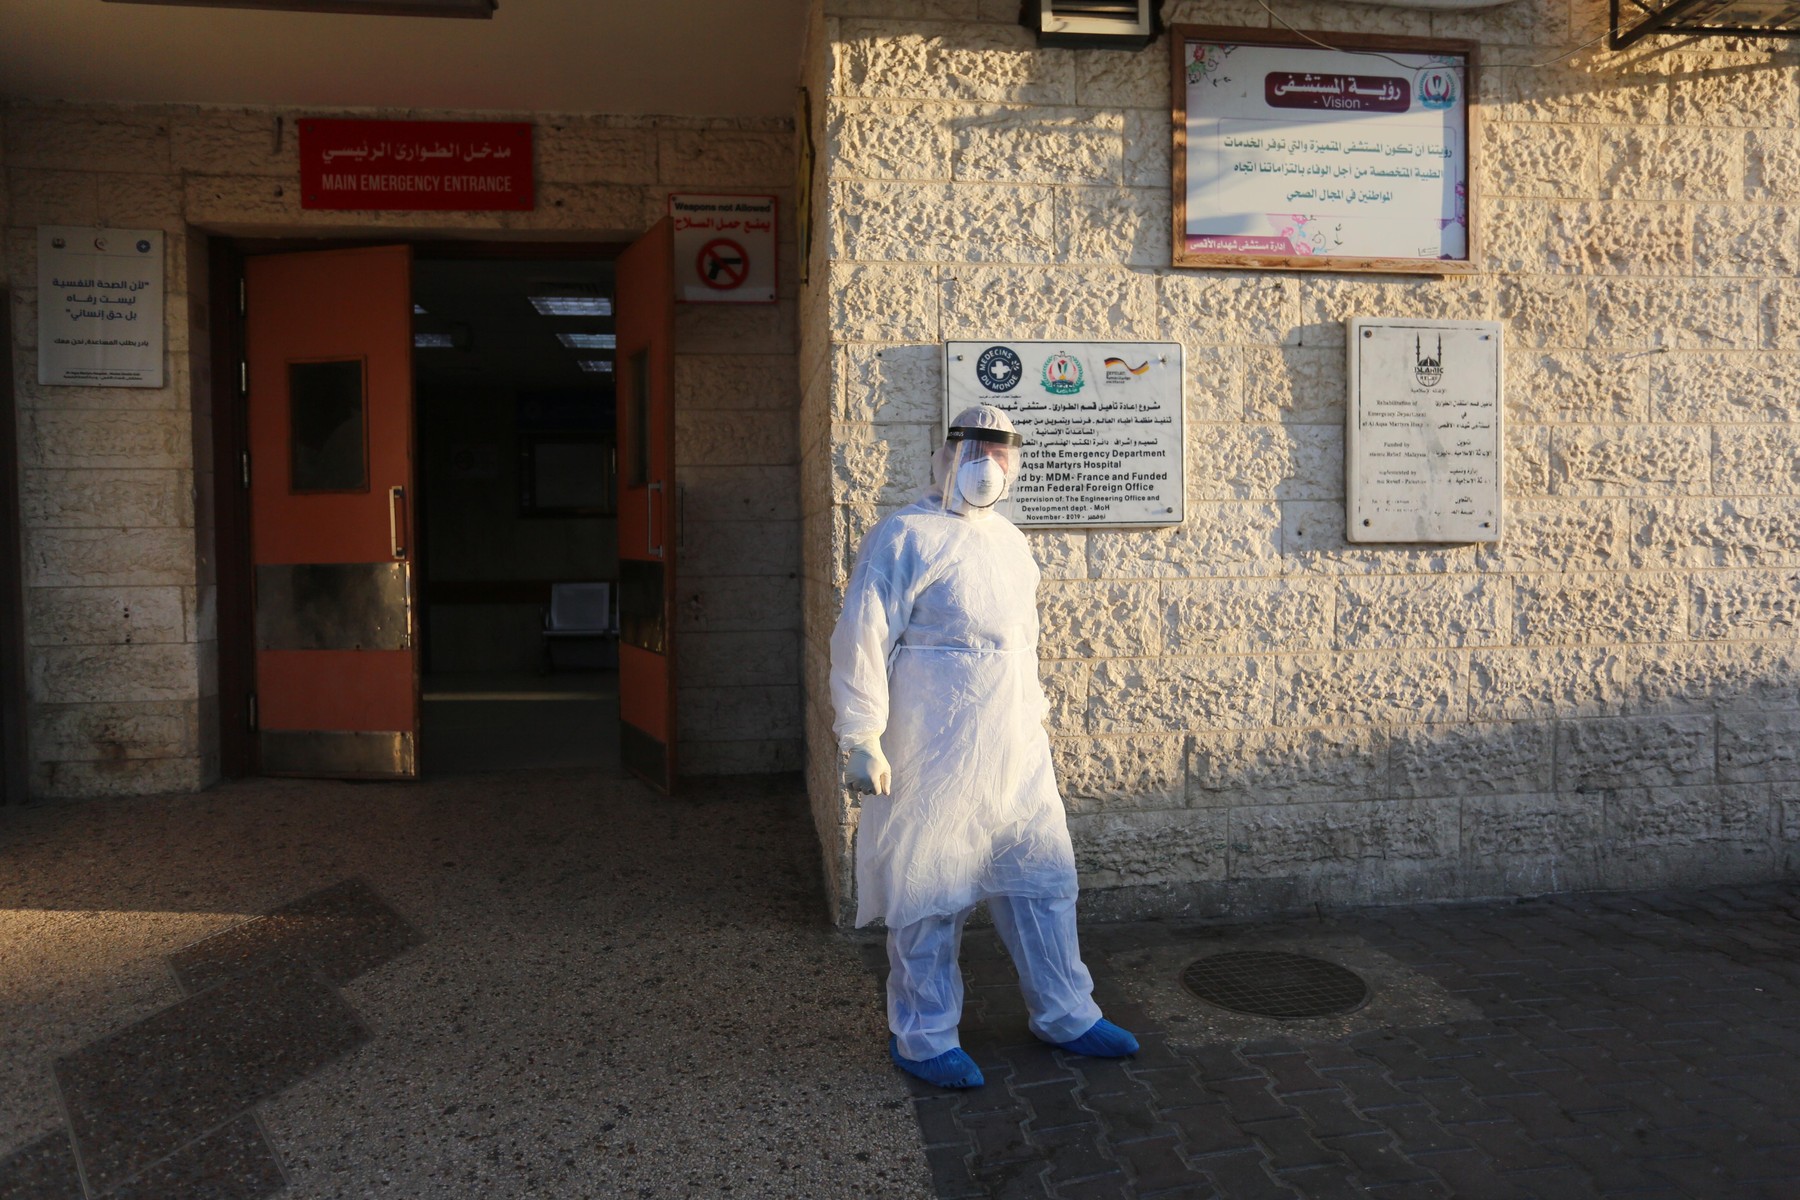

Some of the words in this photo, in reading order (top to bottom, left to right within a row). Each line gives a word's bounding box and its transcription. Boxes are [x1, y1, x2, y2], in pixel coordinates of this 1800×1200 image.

[1274, 73, 1345, 96] المستشفى
[1349, 78, 1401, 101] رؤية
[1321, 95, 1361, 109] Vision
[1224, 136, 1264, 149] الخدمات
[1267, 140, 1286, 151] توفر
[1288, 139, 1308, 155] والتي
[1310, 139, 1342, 154] المتميزة
[1344, 140, 1383, 154] المستشفى
[322, 140, 391, 164] الرئيسي
[394, 142, 460, 162] الطوارئ
[464, 142, 511, 162] مدخل
[1385, 144, 1413, 157] تكون
[1427, 144, 1453, 159] رؤيتنا
[1259, 163, 1305, 176] بالتزاماتنا
[1307, 165, 1331, 177] الوفاء
[1354, 167, 1367, 179] من
[1370, 165, 1412, 178] المتخصصة
[1415, 167, 1444, 181] الطبية
[322, 174, 357, 191] MAIN
[360, 174, 440, 192] EMERGENCY
[444, 175, 512, 192] ENTRANCE
[1287, 188, 1317, 202] الصحي
[1319, 189, 1344, 202] المجال
[1346, 189, 1356, 204] في
[1358, 191, 1393, 204] المواطنين
[675, 203, 716, 212] Weapons
[735, 204, 771, 212] Allowed
[675, 217, 714, 231] السلاح
[716, 217, 741, 231] حمل
[744, 218, 771, 233] يمنع
[1217, 239, 1238, 251] شهداء
[1238, 240, 1269, 251] مستشفى
[52, 278, 94, 289] النفسية
[97, 280, 127, 290] الصحة
[67, 294, 97, 305] رفاه
[100, 295, 136, 305] ليست
[106, 311, 123, 321] حق
[125, 311, 137, 321] بل
[981, 375, 992, 386] DU
[992, 374, 1019, 391] MONDE
[1019, 401, 1047, 412] مستشفى
[1052, 402, 1079, 412] الطوارئ
[1081, 401, 1097, 412] قسم
[1098, 401, 1118, 412] تأهيل
[1138, 401, 1161, 412] مشروع
[1034, 417, 1043, 426] من
[1071, 417, 1091, 425] فرنسا
[1096, 417, 1116, 425] العالم
[1030, 450, 1039, 458] of
[1041, 450, 1056, 458] the
[1058, 450, 1110, 460] Emergency
[1112, 449, 1166, 460] Department
[1021, 461, 1045, 471] Aqsa
[1046, 461, 1082, 470] Martyrs
[1083, 460, 1122, 470] Hospital
[1076, 472, 1110, 481] France
[1112, 472, 1129, 481] and
[1131, 471, 1168, 481] Funded
[1047, 484, 1084, 492] Federal
[1086, 483, 1123, 494] Foreign
[1125, 482, 1154, 491] Office
[1016, 496, 1054, 504] upervision
[1080, 495, 1123, 503] Engineering
